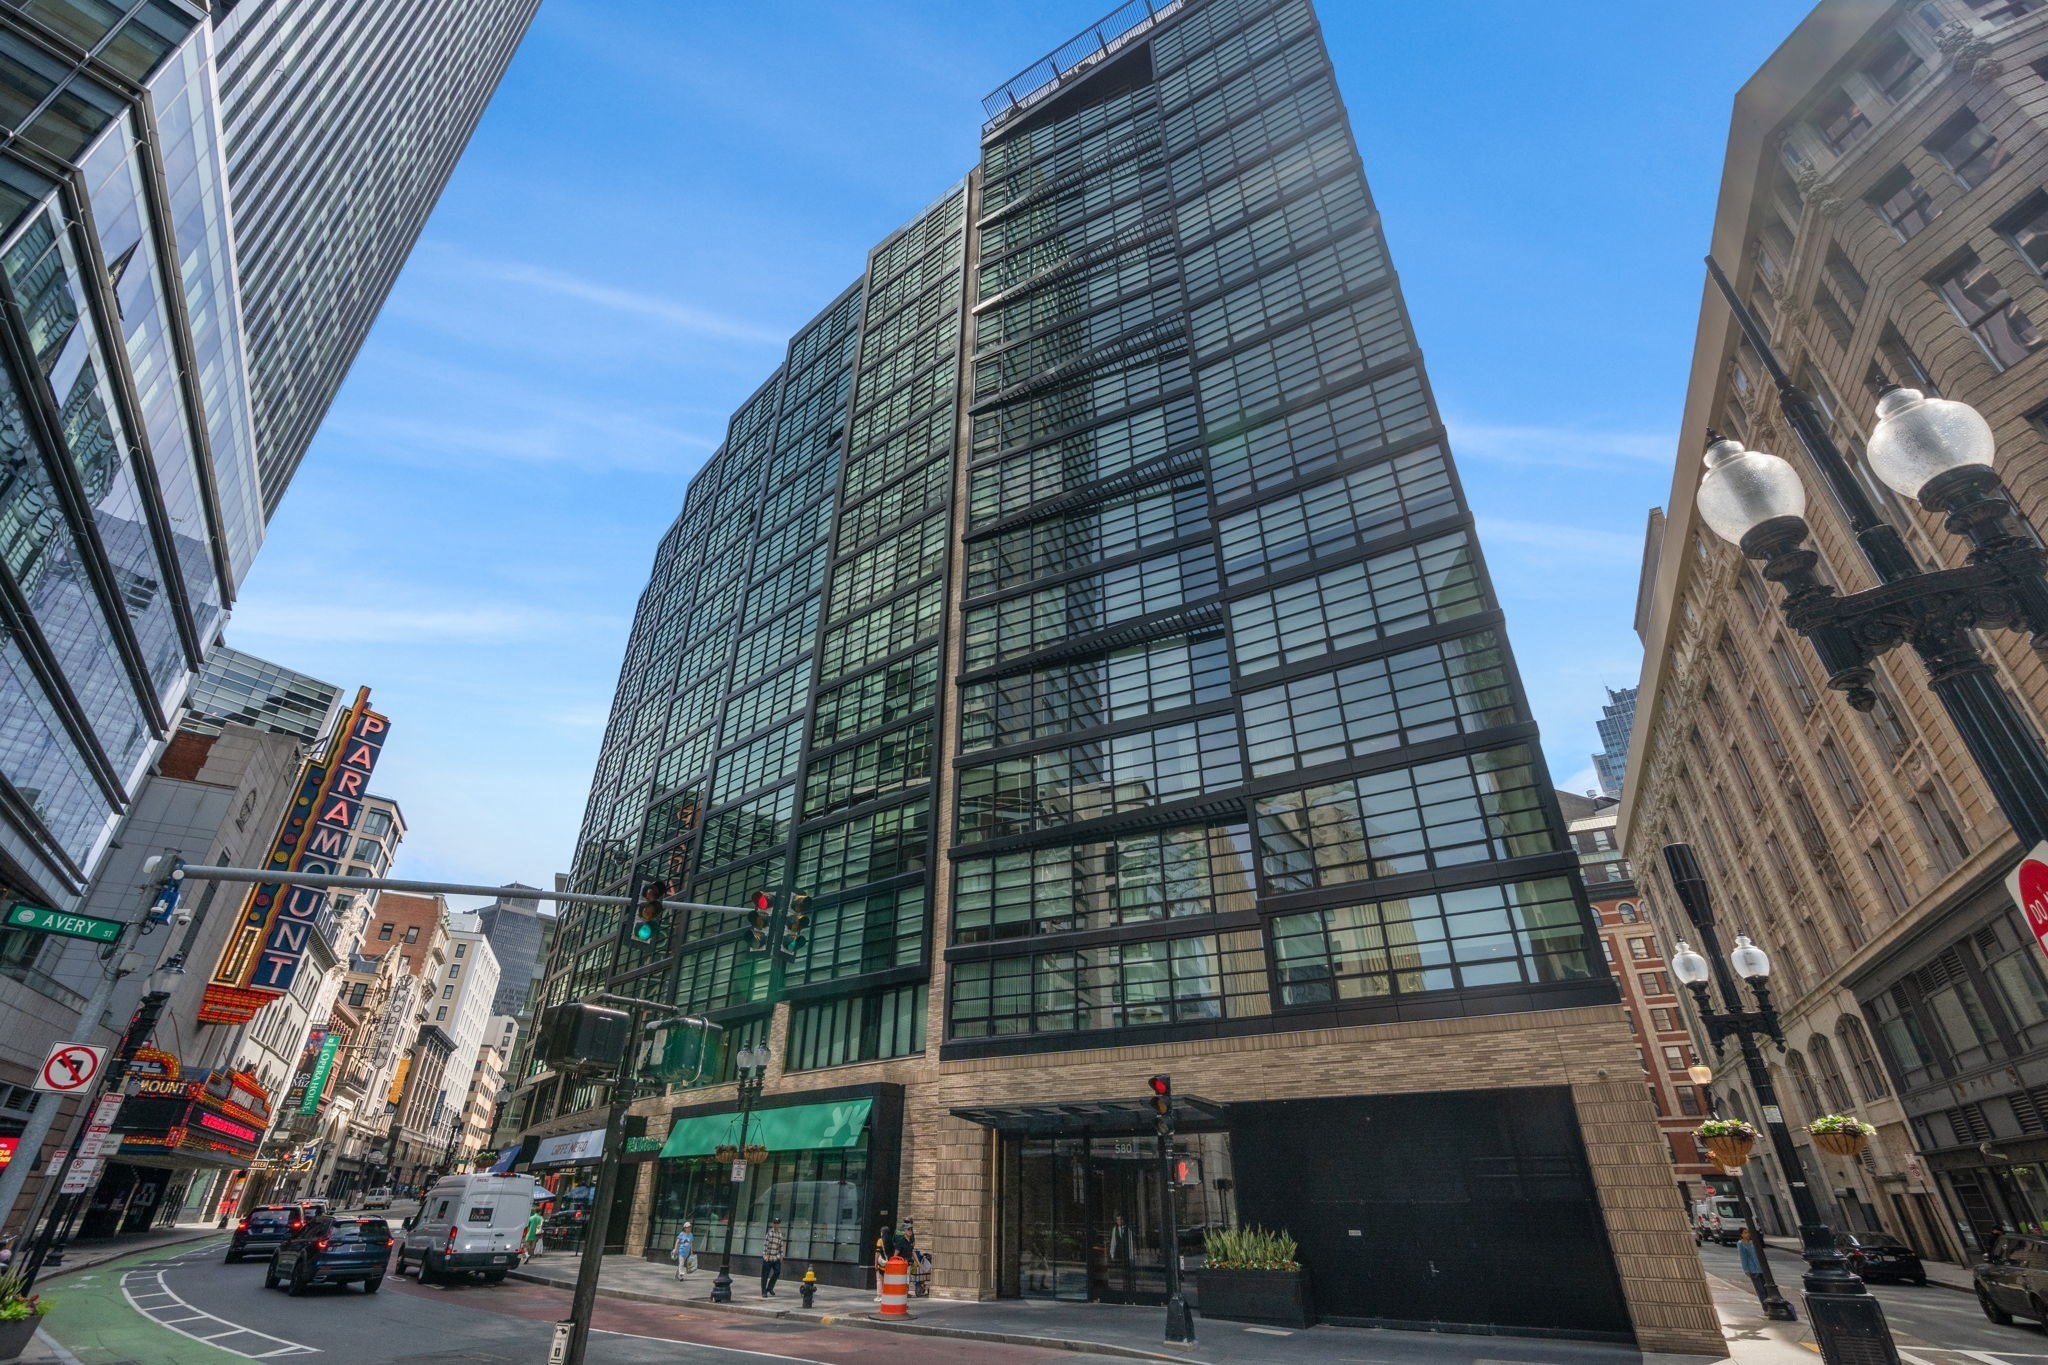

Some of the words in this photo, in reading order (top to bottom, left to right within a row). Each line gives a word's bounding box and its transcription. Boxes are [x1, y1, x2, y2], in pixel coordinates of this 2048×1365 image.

[268, 716, 384, 985] PARAMOUNT
[42, 914, 96, 934] AVERY
[378, 993, 408, 1060] MODERN
[313, 1053, 330, 1081] OPERA
[304, 1082, 319, 1110] HOUSE
[1115, 1144, 1132, 1153] 580
